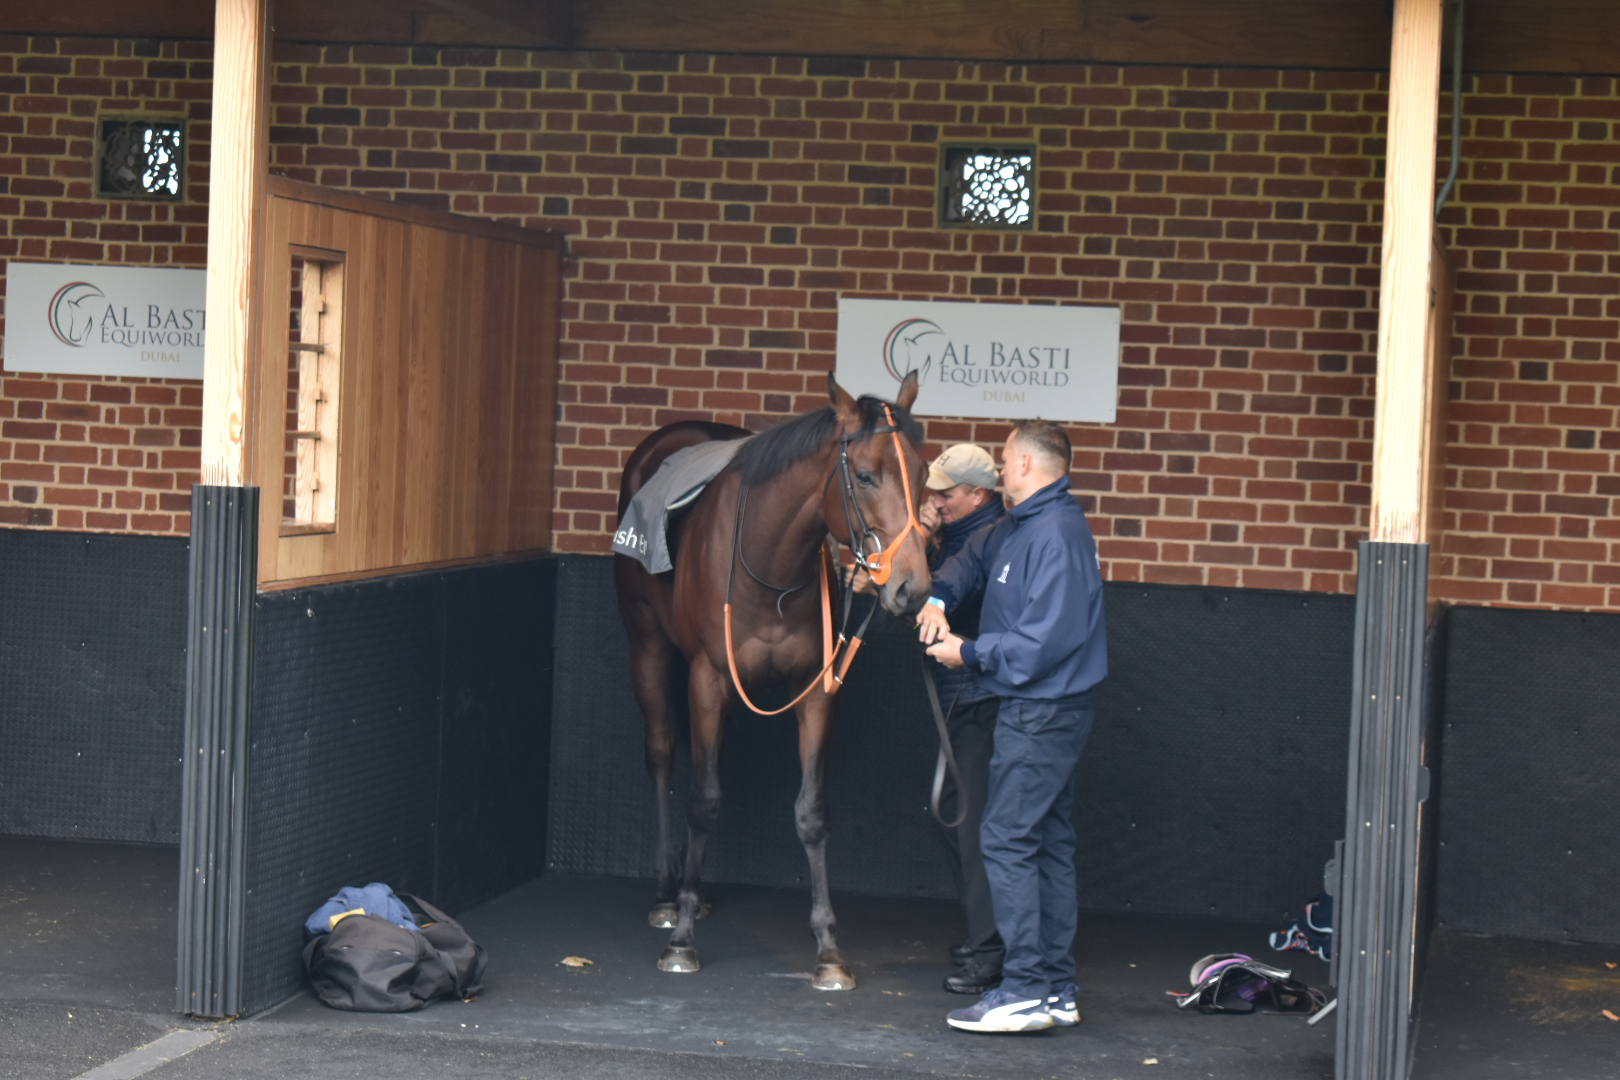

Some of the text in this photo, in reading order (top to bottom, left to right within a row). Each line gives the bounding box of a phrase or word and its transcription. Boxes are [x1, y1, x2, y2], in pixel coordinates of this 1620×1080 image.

[100, 303, 206, 331] AL BAST
[100, 326, 205, 348] EQUIWORL
[140, 351, 180, 363] DUBAI
[939, 340, 1071, 370] AL BASTI
[940, 364, 1070, 387] EQUIWORLD
[982, 390, 1026, 403] DUBAI
